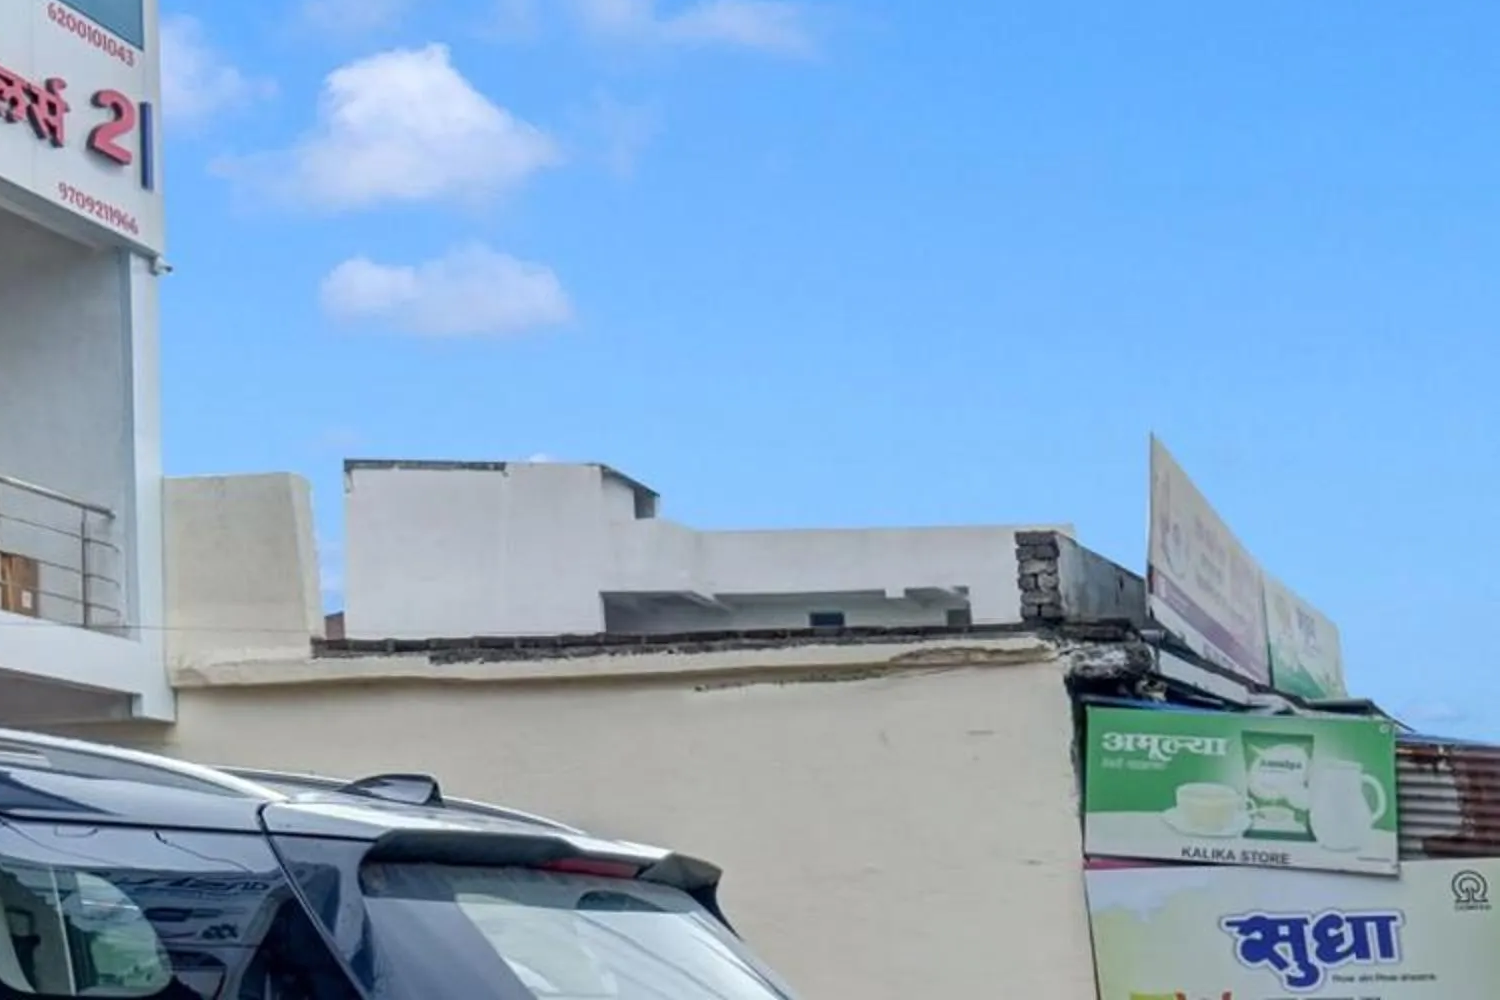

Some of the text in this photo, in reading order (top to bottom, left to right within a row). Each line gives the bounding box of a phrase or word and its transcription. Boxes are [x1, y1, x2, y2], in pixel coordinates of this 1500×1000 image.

[47, 2, 135, 67] 6200101043
[86, 89, 136, 165] 2
[57, 181, 140, 236] 9709211966
[1180, 845, 1291, 866] KALIKA STORE
[1224, 913, 1399, 988] सुधा
